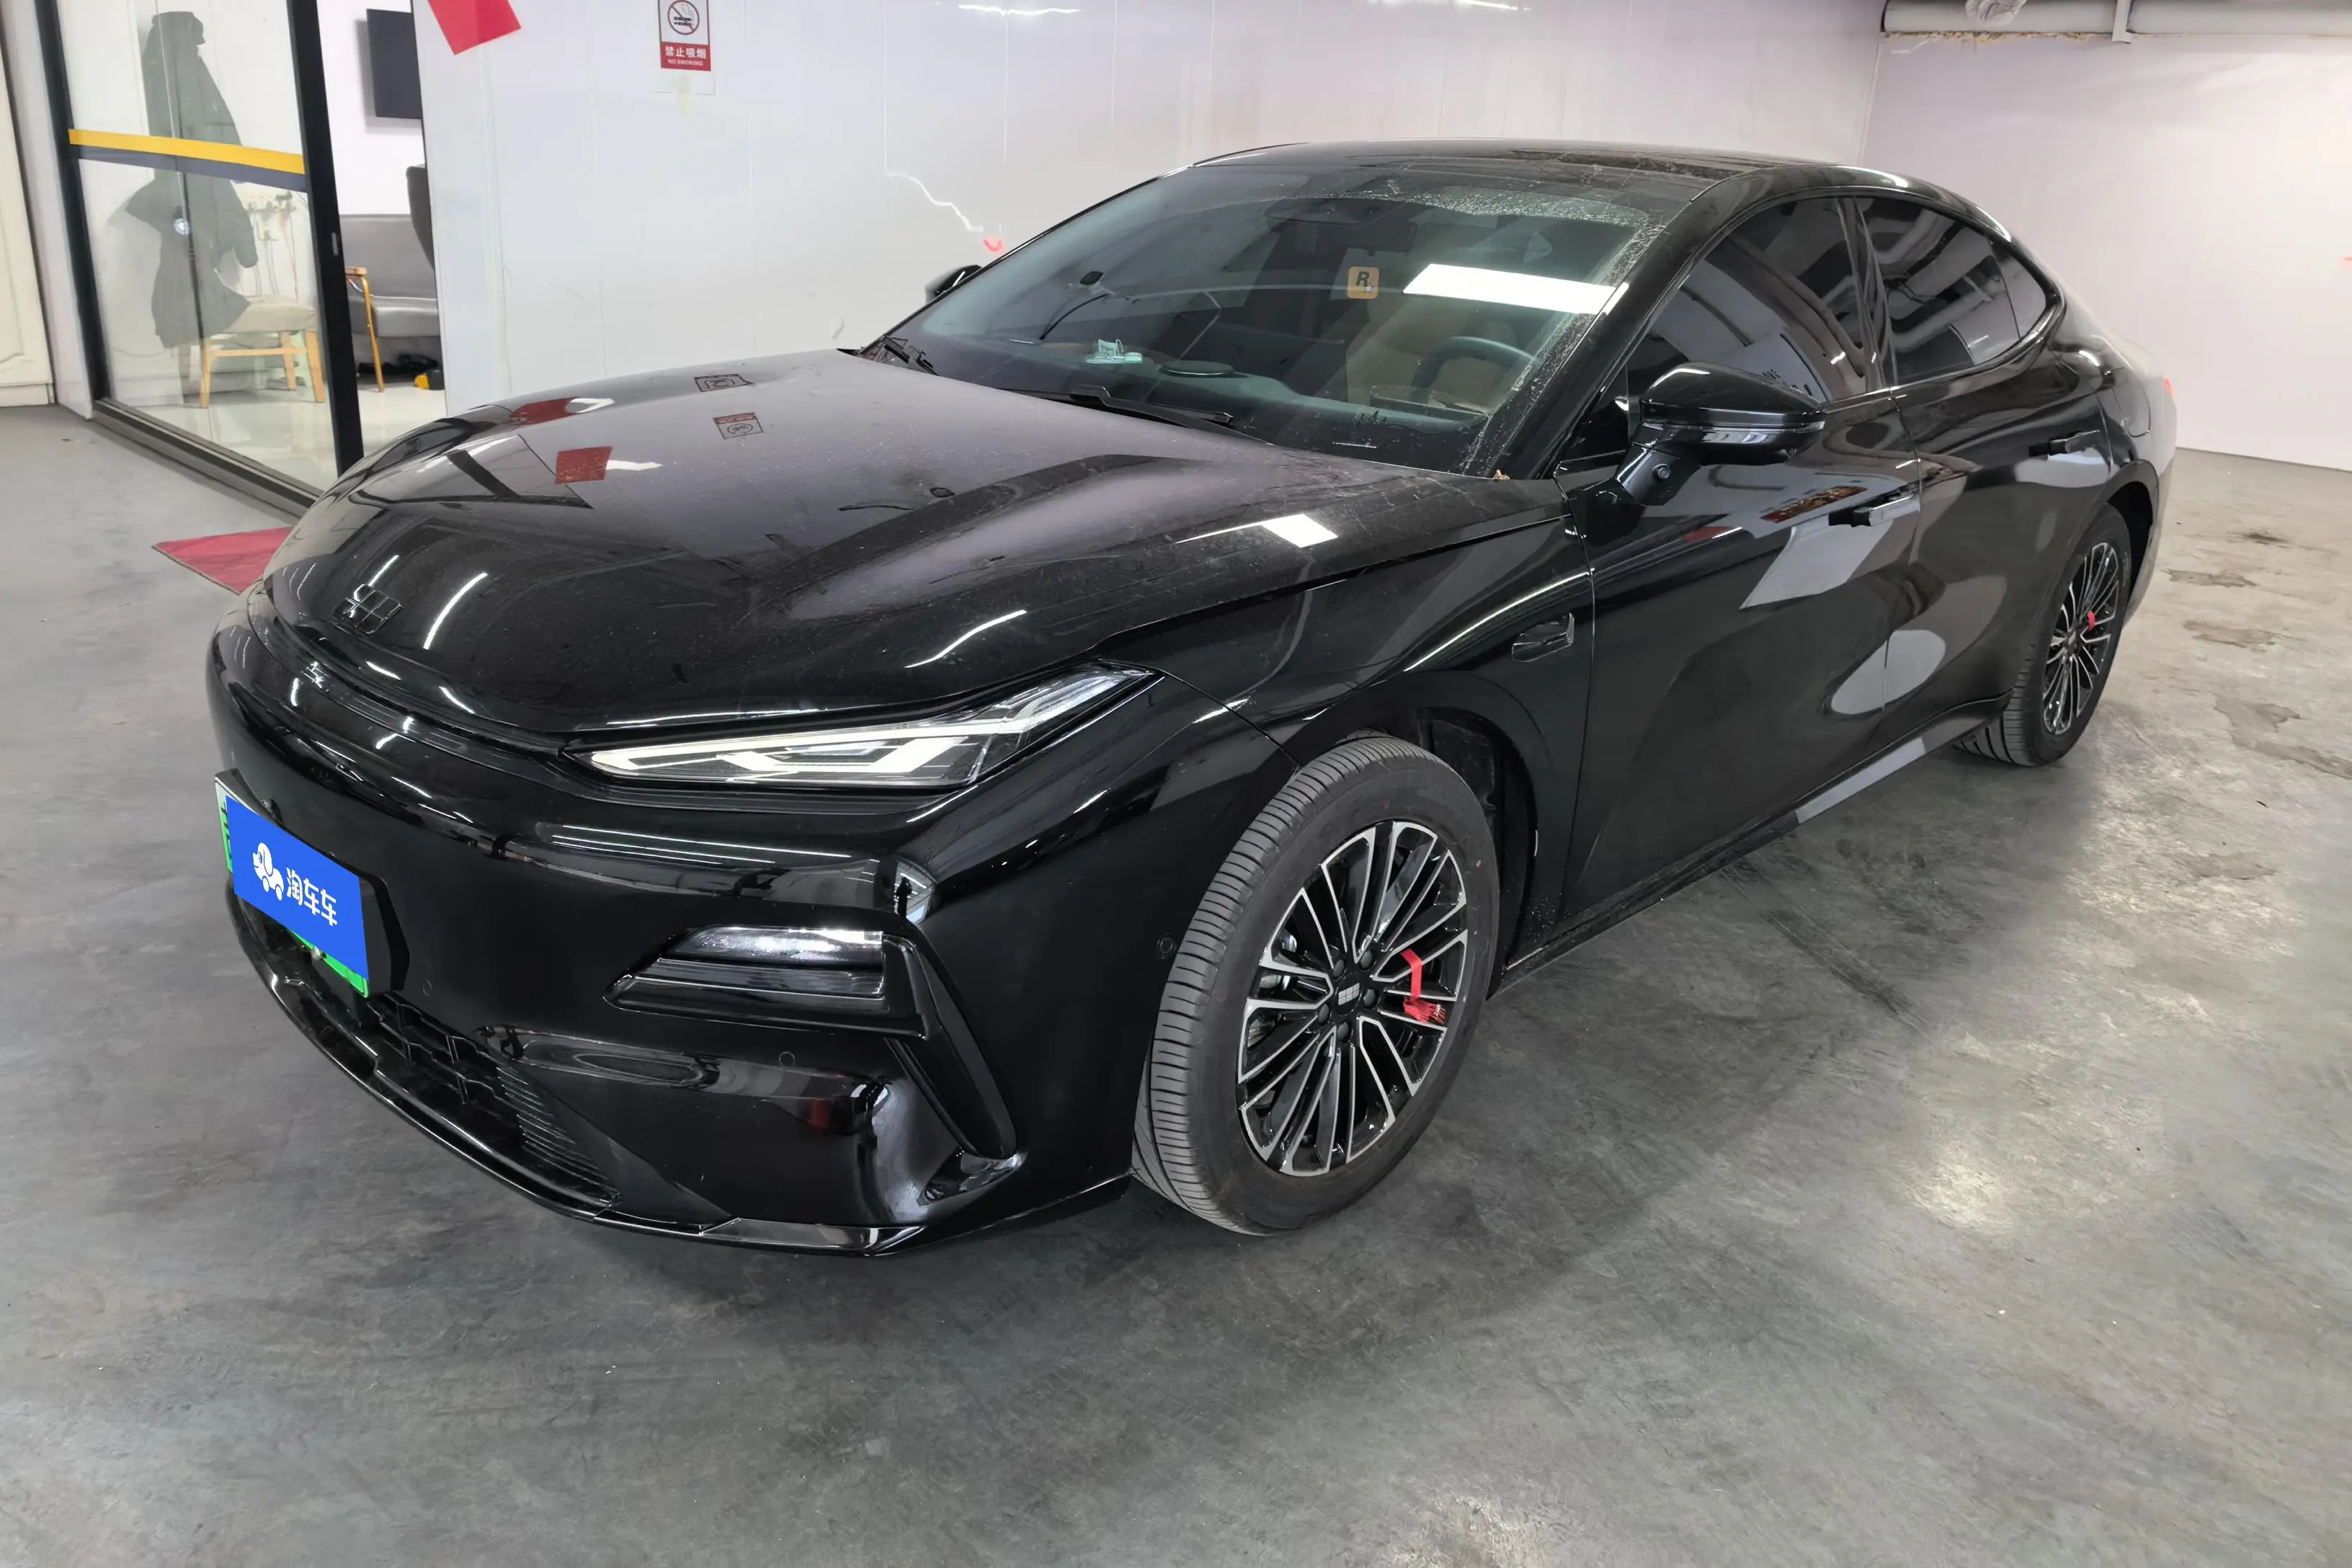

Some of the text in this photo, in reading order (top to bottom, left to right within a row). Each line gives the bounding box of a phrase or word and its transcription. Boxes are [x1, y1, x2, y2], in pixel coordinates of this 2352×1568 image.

[665, 46, 706, 58] 禁止吸烟
[1355, 271, 1370, 286] R
